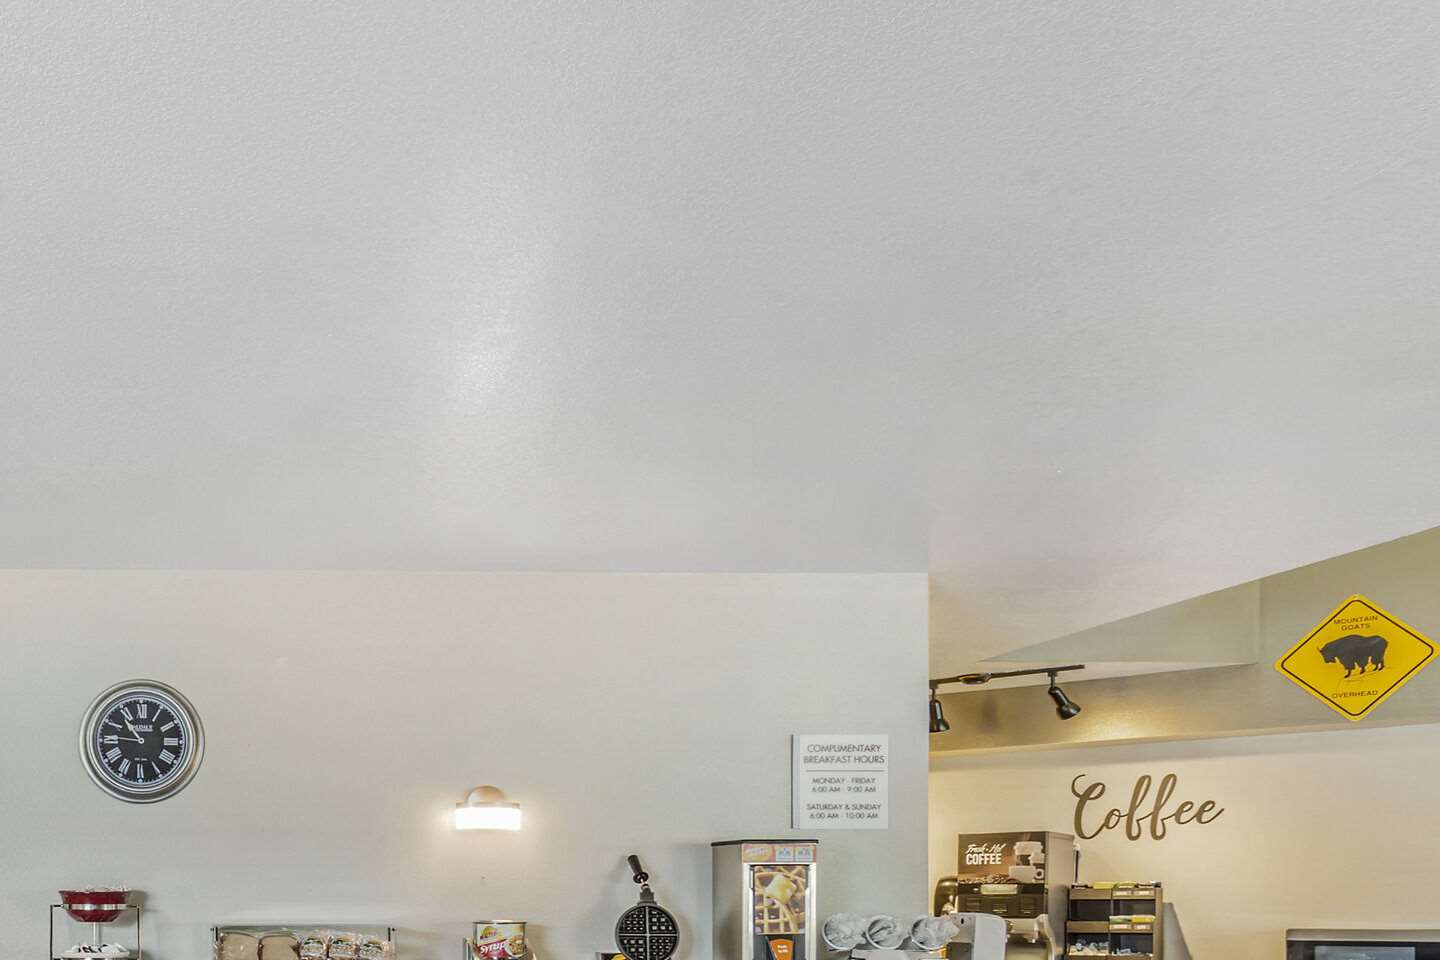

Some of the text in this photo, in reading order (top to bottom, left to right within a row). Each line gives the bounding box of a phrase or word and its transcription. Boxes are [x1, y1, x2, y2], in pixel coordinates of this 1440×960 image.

[1333, 615, 1378, 624] MOUNTAIN
[1340, 623, 1371, 631] GOATS
[1331, 690, 1378, 699] OVERHEAD
[807, 744, 881, 753] COMPLIMENTARY
[803, 755, 885, 764] BREAKFAST HOURS
[806, 803, 842, 811] SATURDAY
[851, 803, 881, 811] SUNDAY
[1071, 773, 1225, 841] Coffee
[965, 853, 1002, 865] COFFEE
